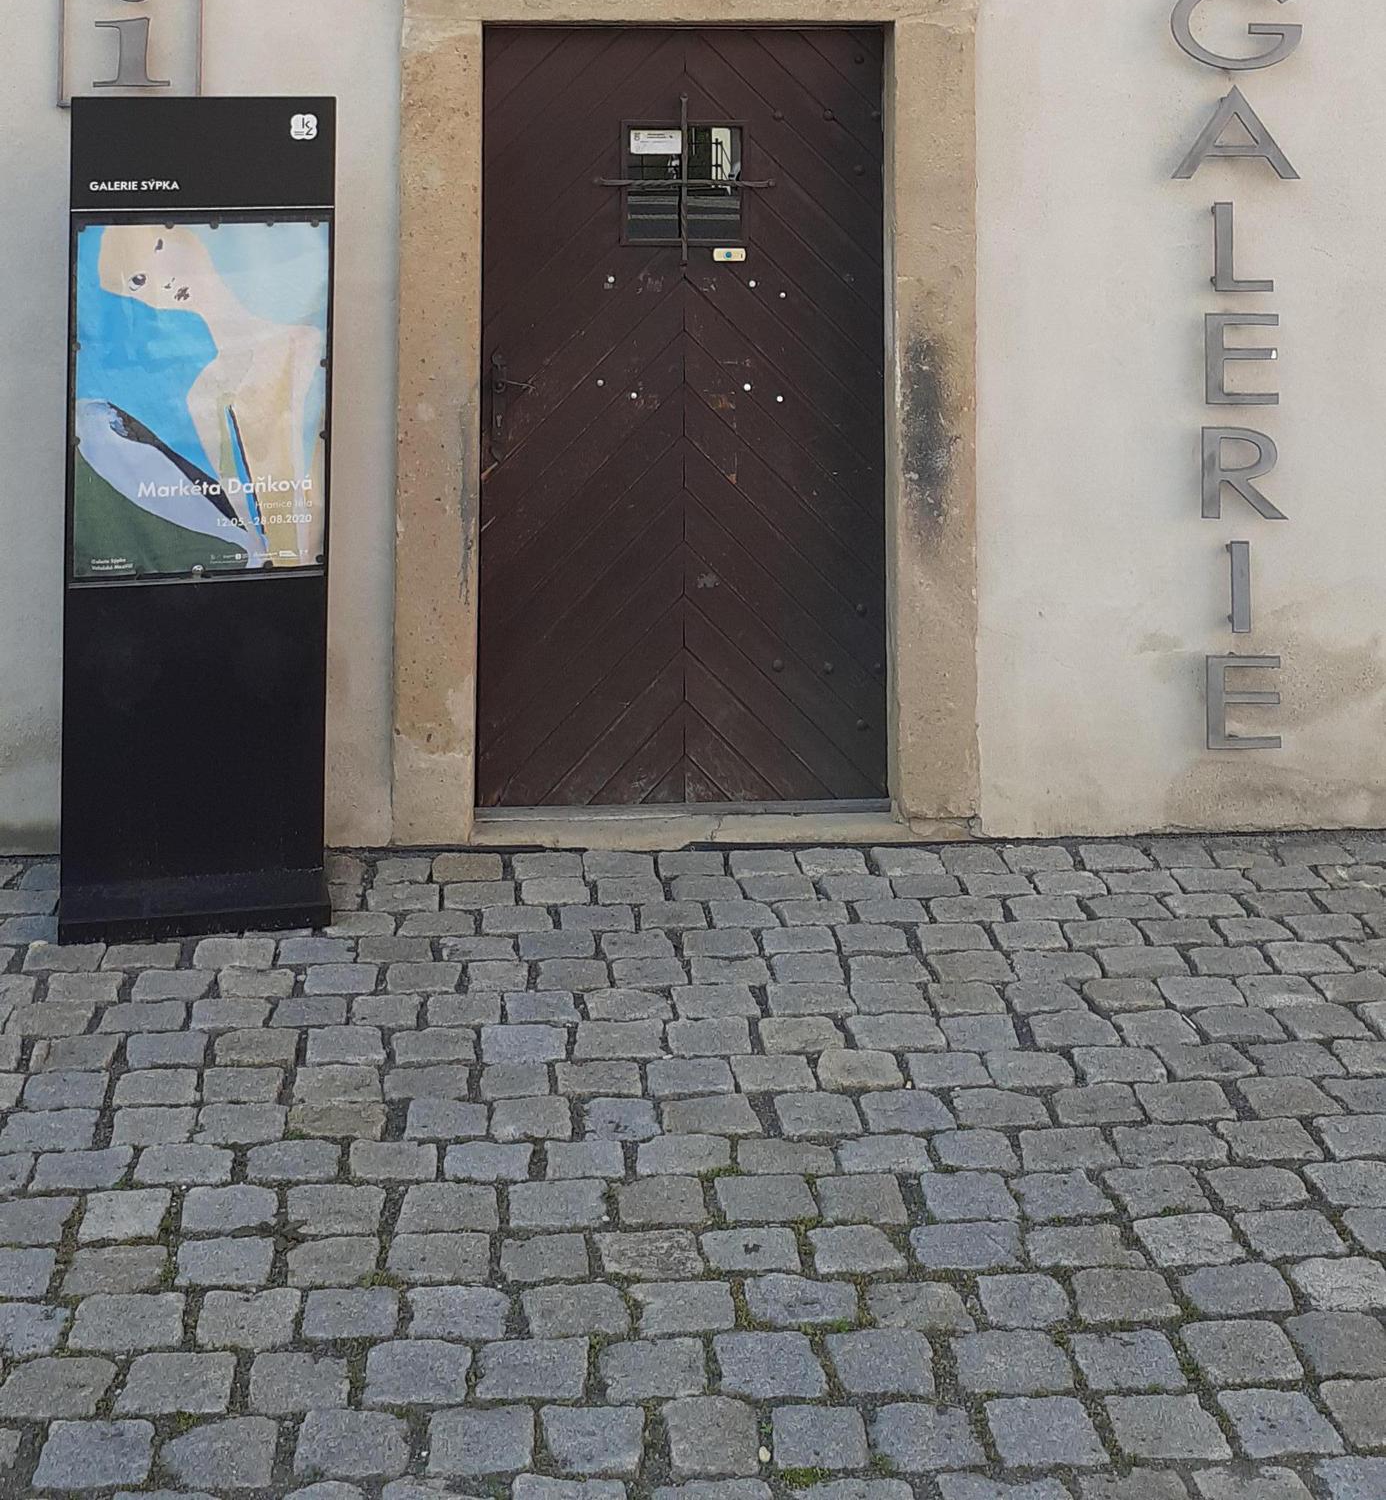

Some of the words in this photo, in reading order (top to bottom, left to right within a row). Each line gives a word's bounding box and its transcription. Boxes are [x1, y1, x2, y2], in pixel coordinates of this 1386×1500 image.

[89, 180, 138, 191] GALERIE
[140, 178, 180, 191] SÝPKA
[137, 479, 221, 498] Markéta
[228, 474, 312, 494] Daňková
